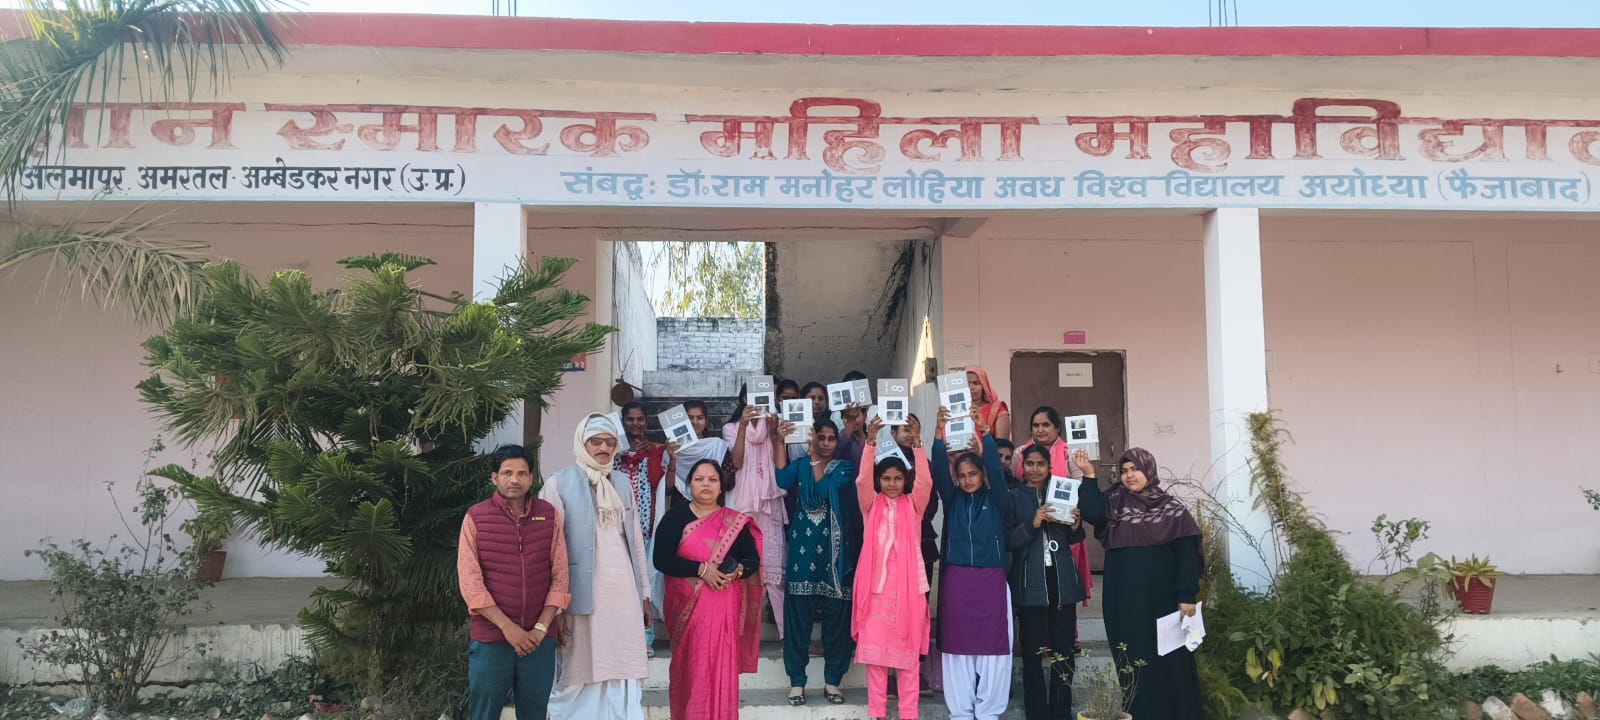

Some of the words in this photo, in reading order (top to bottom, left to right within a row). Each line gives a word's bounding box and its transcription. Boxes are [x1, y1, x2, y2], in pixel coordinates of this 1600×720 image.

[264, 103, 657, 157] स्मारक
[685, 97, 1039, 175] महिला
[775, 169, 877, 202] मनोहर
[882, 169, 985, 203] लोहिया
[994, 177, 1065, 198] अवध
[1299, 167, 1428, 198] अयोध्या
